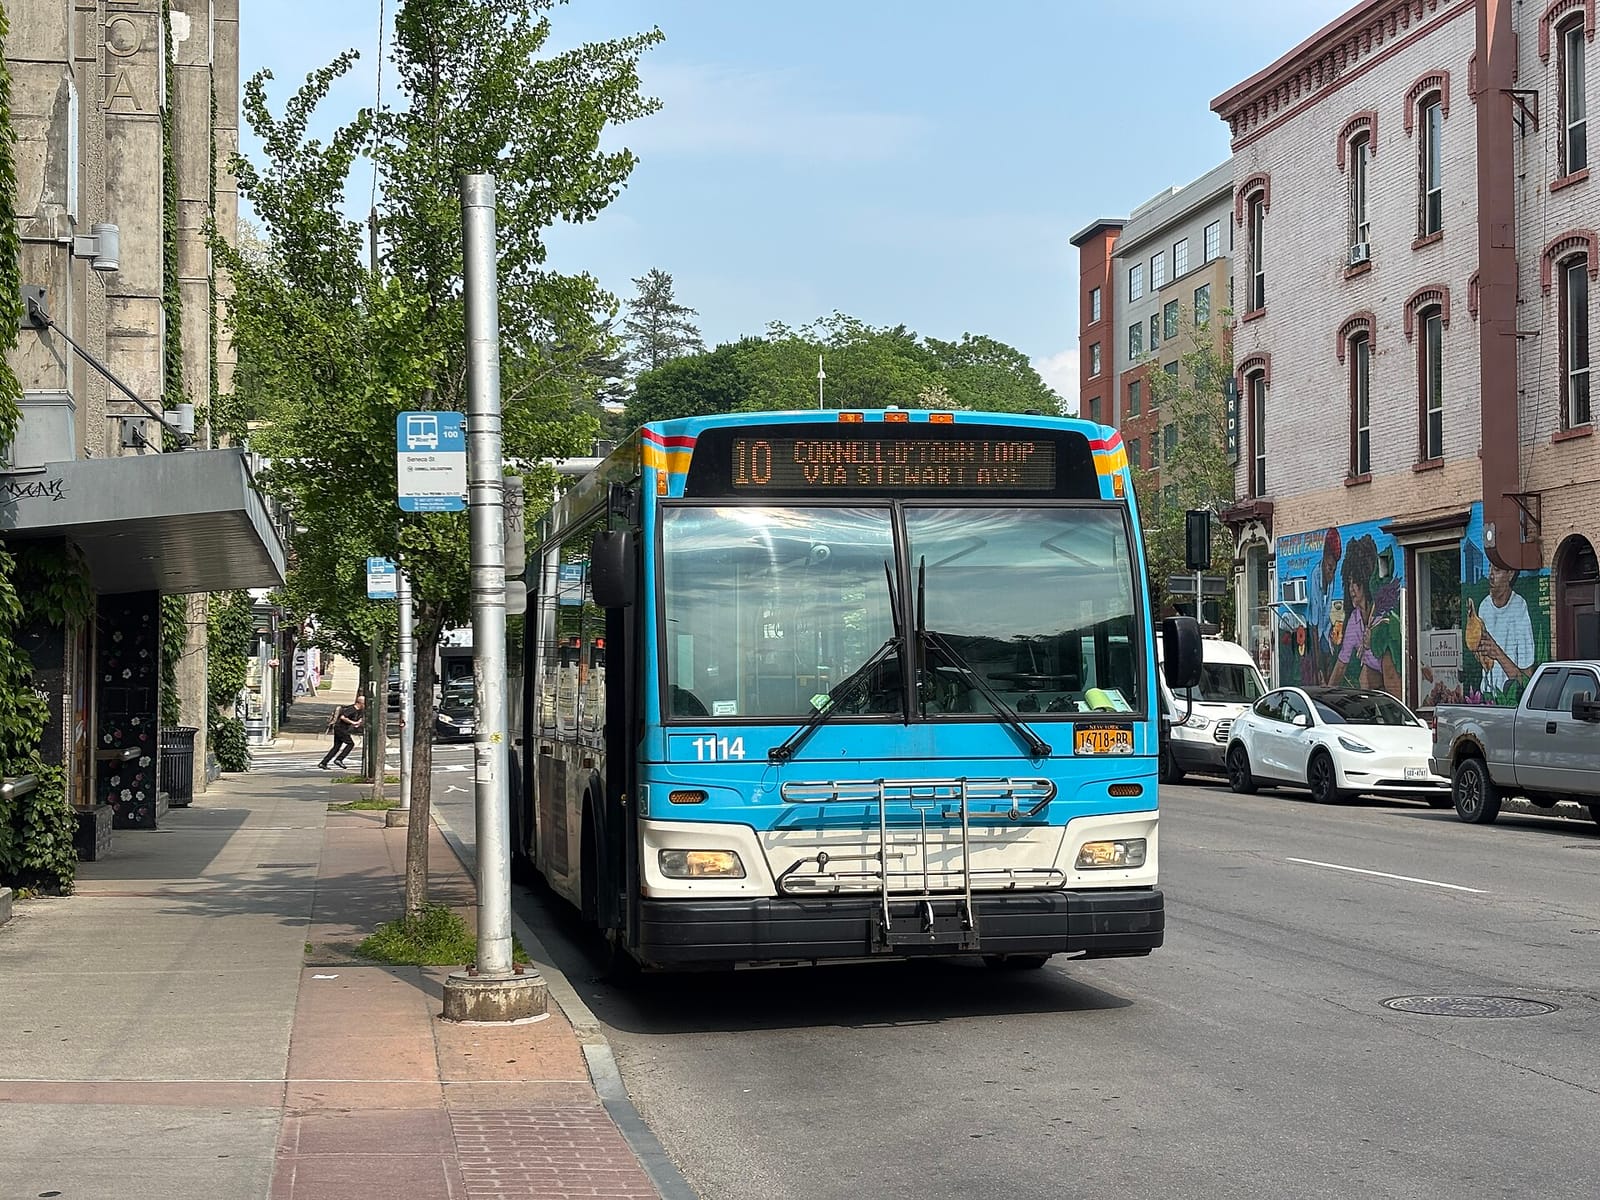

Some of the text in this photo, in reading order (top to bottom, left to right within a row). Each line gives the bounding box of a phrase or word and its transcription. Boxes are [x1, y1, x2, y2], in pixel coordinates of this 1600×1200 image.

[735, 441, 772, 484] 10
[983, 442, 1035, 463] LOOP
[803, 465, 847, 484] VIA
[857, 465, 966, 485] STEWART
[295, 656, 305, 693] SPA
[692, 736, 745, 761] 1114
